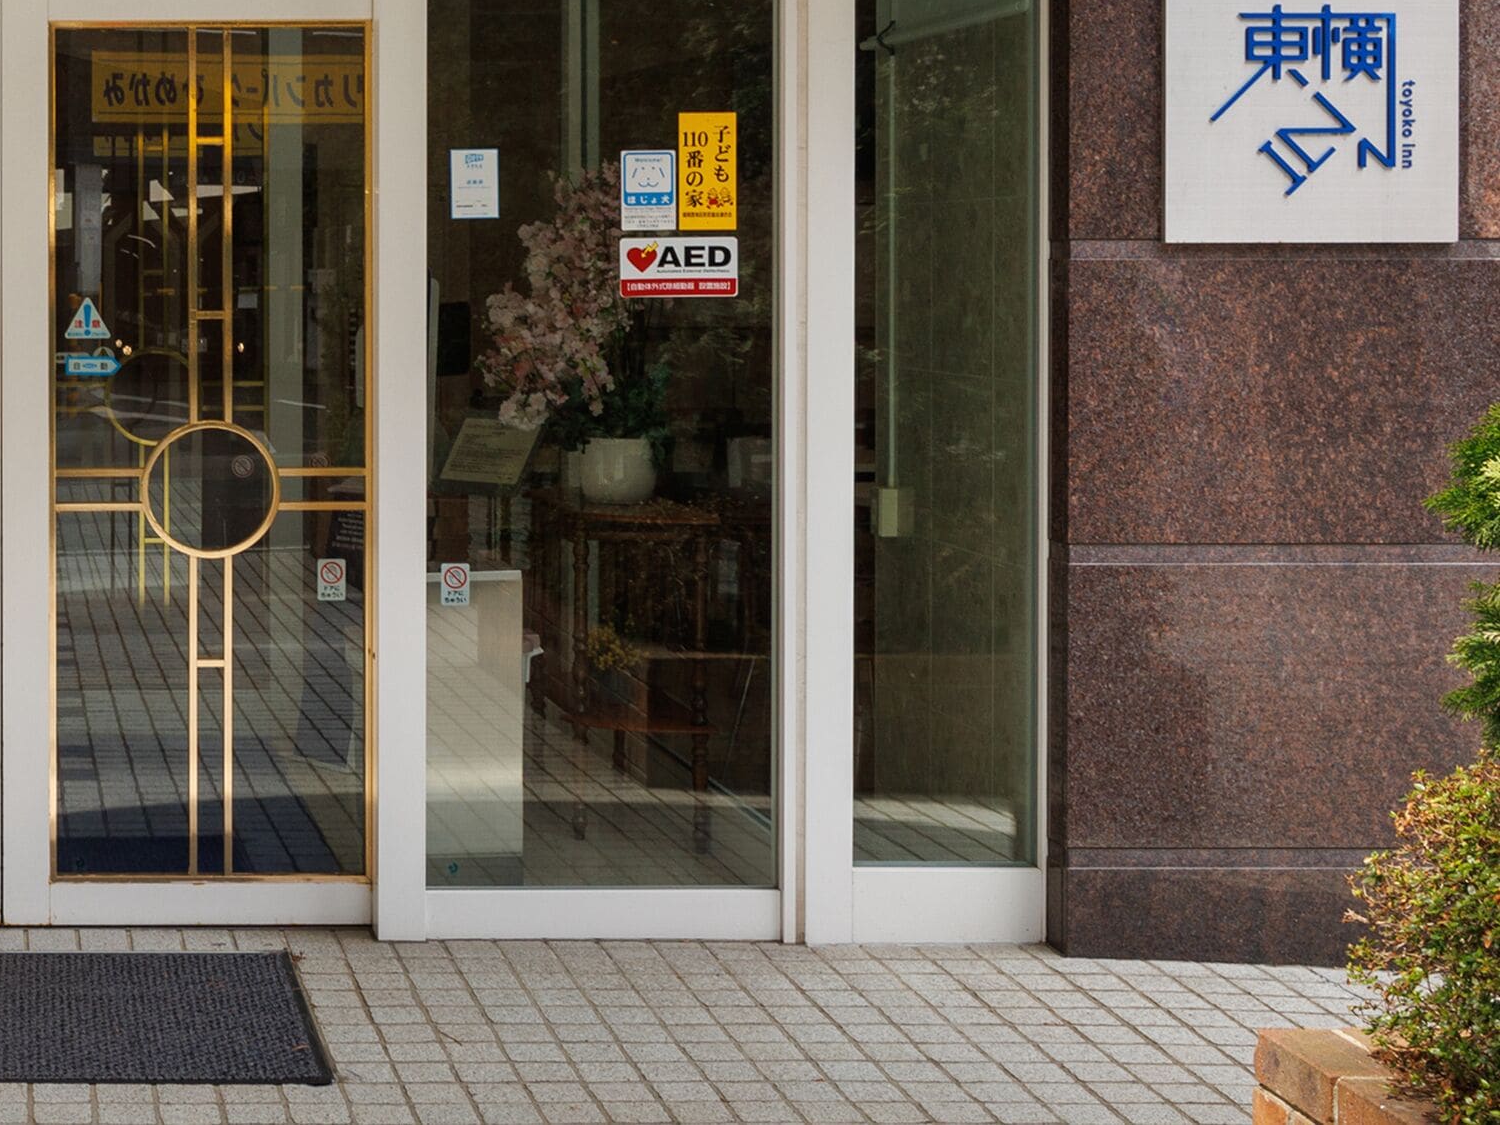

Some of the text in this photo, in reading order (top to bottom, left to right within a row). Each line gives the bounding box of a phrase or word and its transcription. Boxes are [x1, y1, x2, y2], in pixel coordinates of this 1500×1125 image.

[713, 125, 732, 183] 子ども
[1400, 79, 1416, 169] toyoko inn
[682, 131, 709, 208] 110番の家
[657, 246, 731, 267] AED
